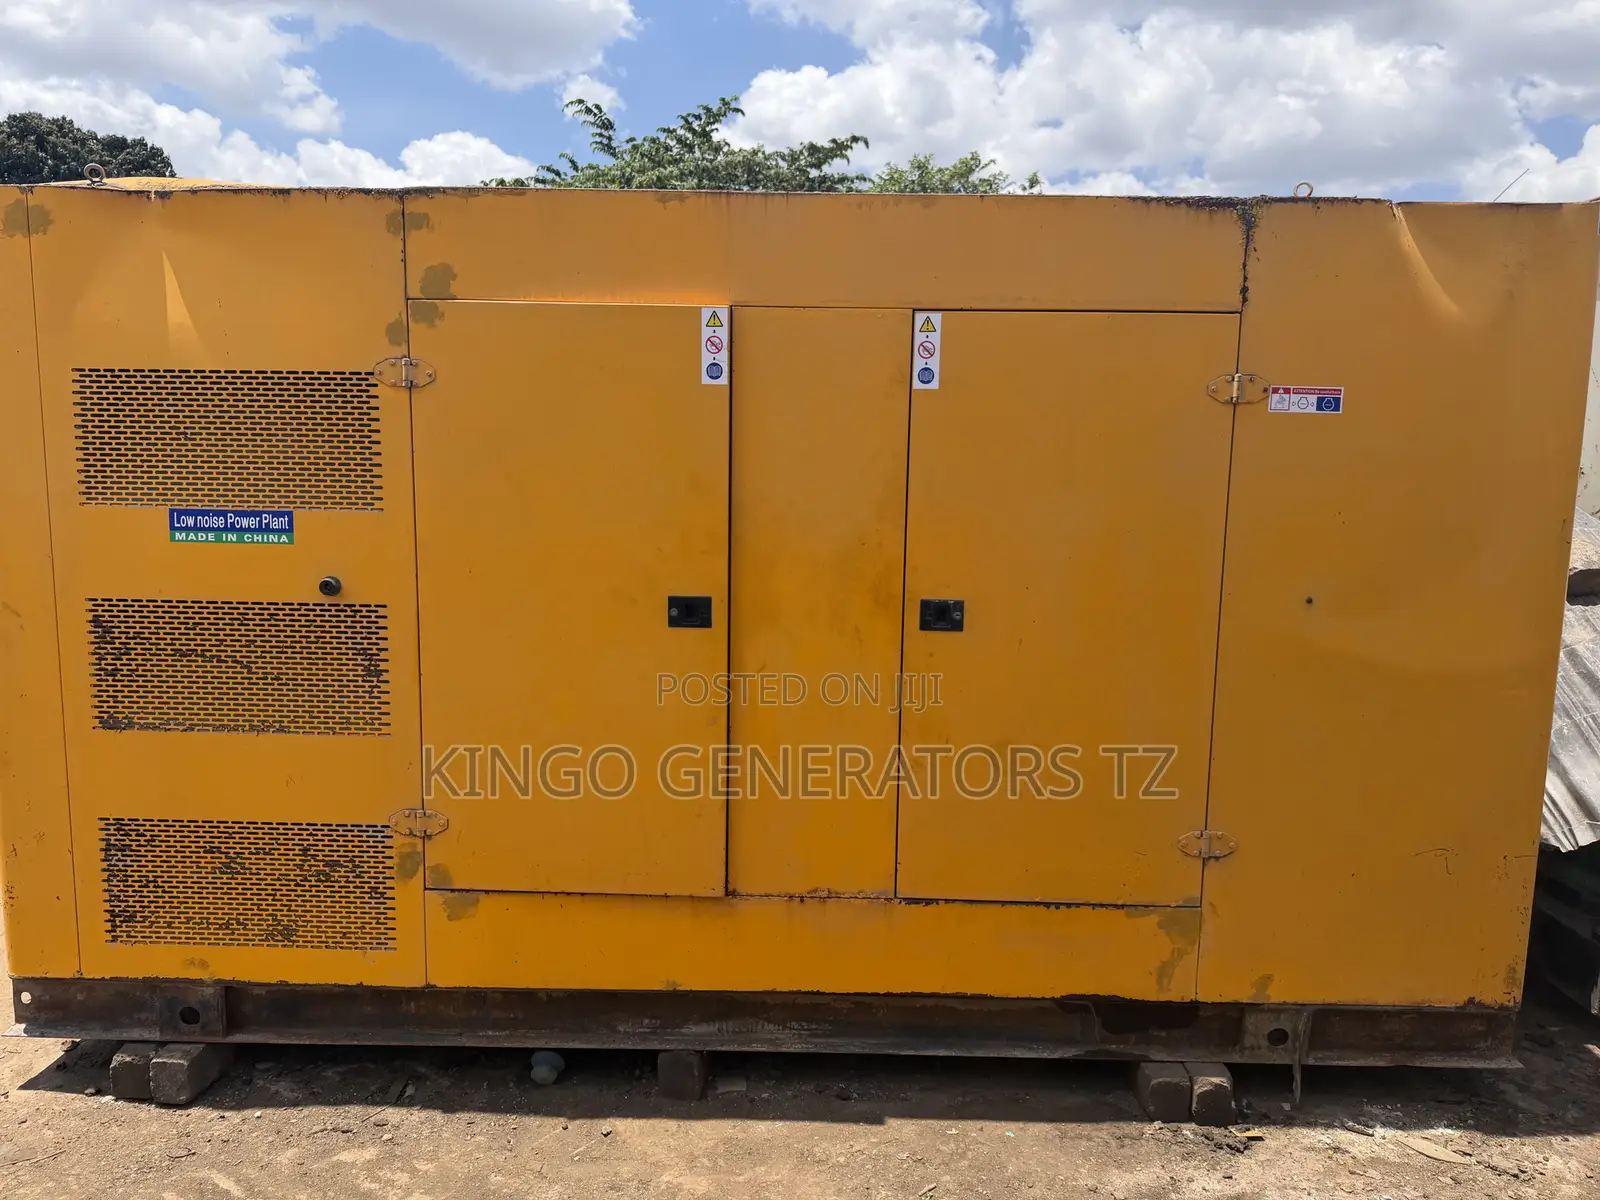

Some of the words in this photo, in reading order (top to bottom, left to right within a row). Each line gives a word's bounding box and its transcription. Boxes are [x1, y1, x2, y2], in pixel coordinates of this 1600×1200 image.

[174, 512, 195, 528] Low
[197, 512, 225, 528] noise
[227, 513, 260, 529] Power
[262, 513, 289, 529] Plant
[175, 532, 216, 541] MADE
[222, 533, 237, 542] IN
[244, 533, 289, 543] CHINA
